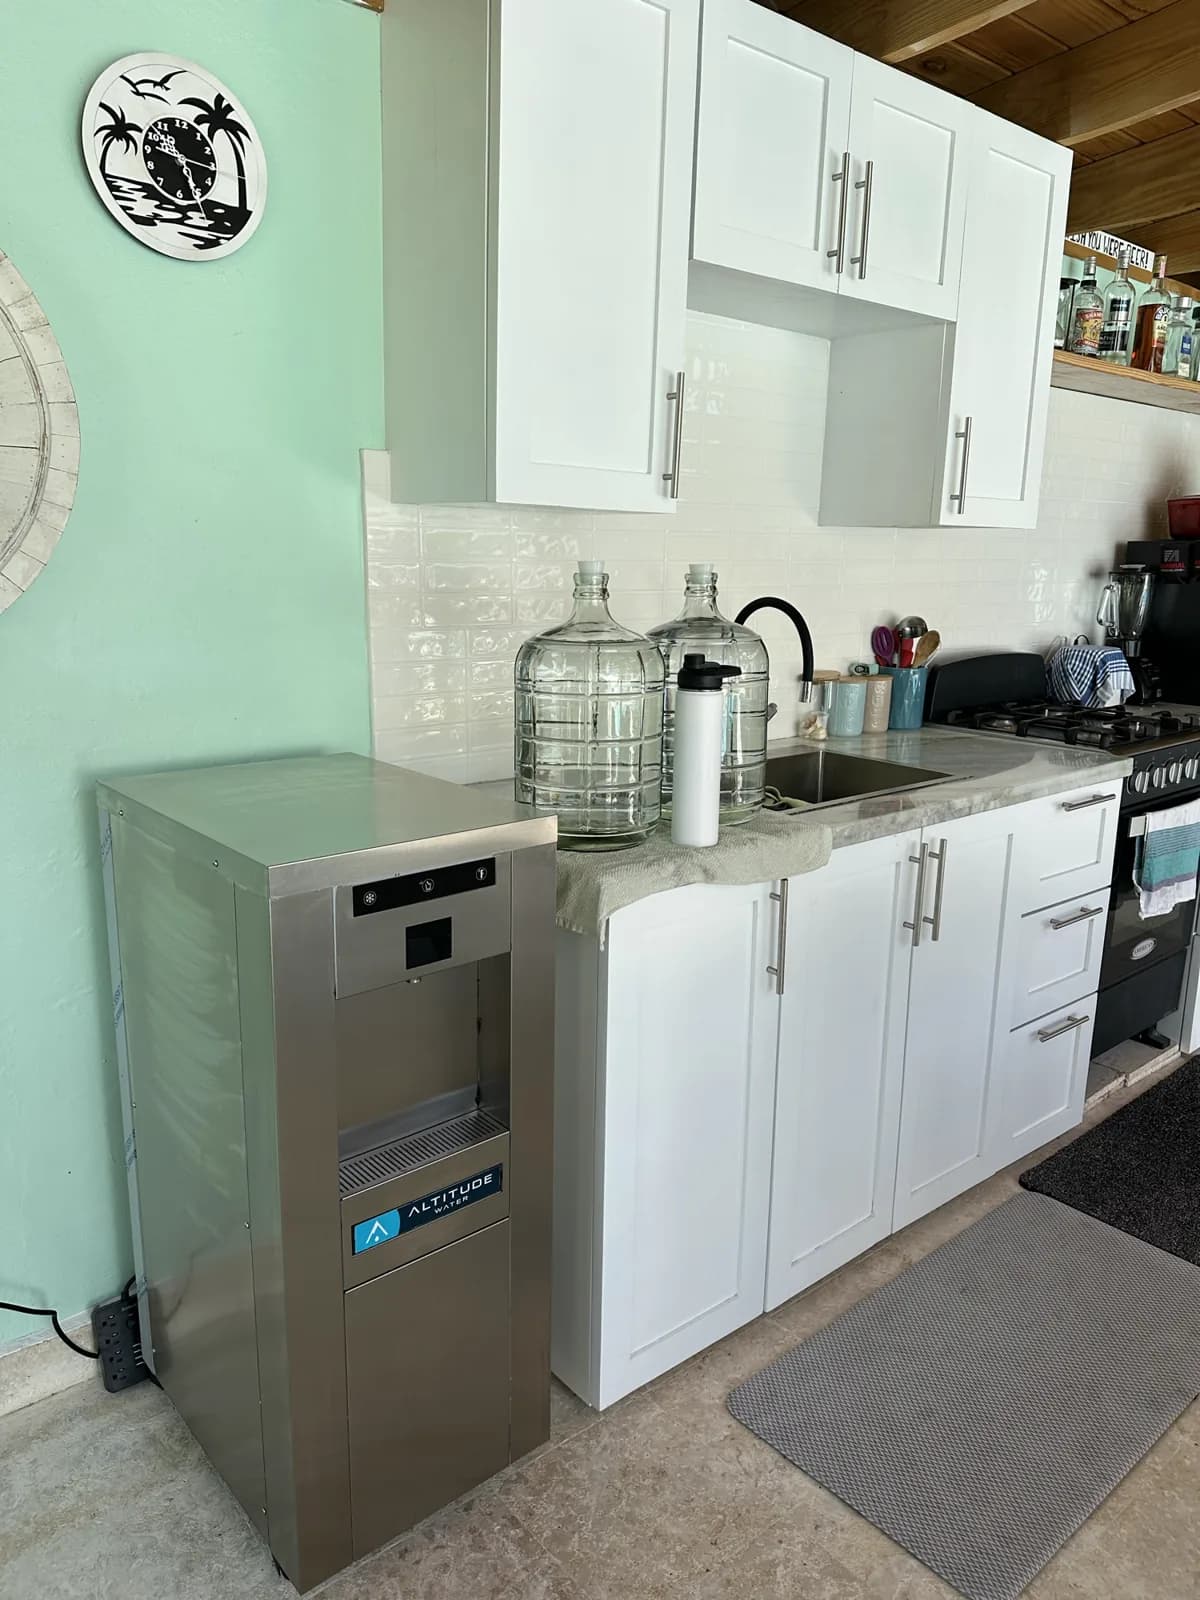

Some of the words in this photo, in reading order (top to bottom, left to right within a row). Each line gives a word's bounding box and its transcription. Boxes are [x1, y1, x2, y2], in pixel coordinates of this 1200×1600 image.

[157, 121, 168, 131] 11
[175, 119, 188, 129] 12
[147, 132, 159, 141] 10
[196, 132, 202, 141] 1
[144, 145, 151, 154] 9
[204, 146, 211, 155] 2
[147, 161, 154, 170] 8
[209, 162, 216, 171] 3
[157, 177, 164, 186] 7
[205, 177, 212, 186] 4
[176, 189, 183, 198] 6
[1087, 231, 1101, 250] YOU
[408, 1173, 493, 1218] ALTITUDE
[434, 1195, 469, 1214] WATER
